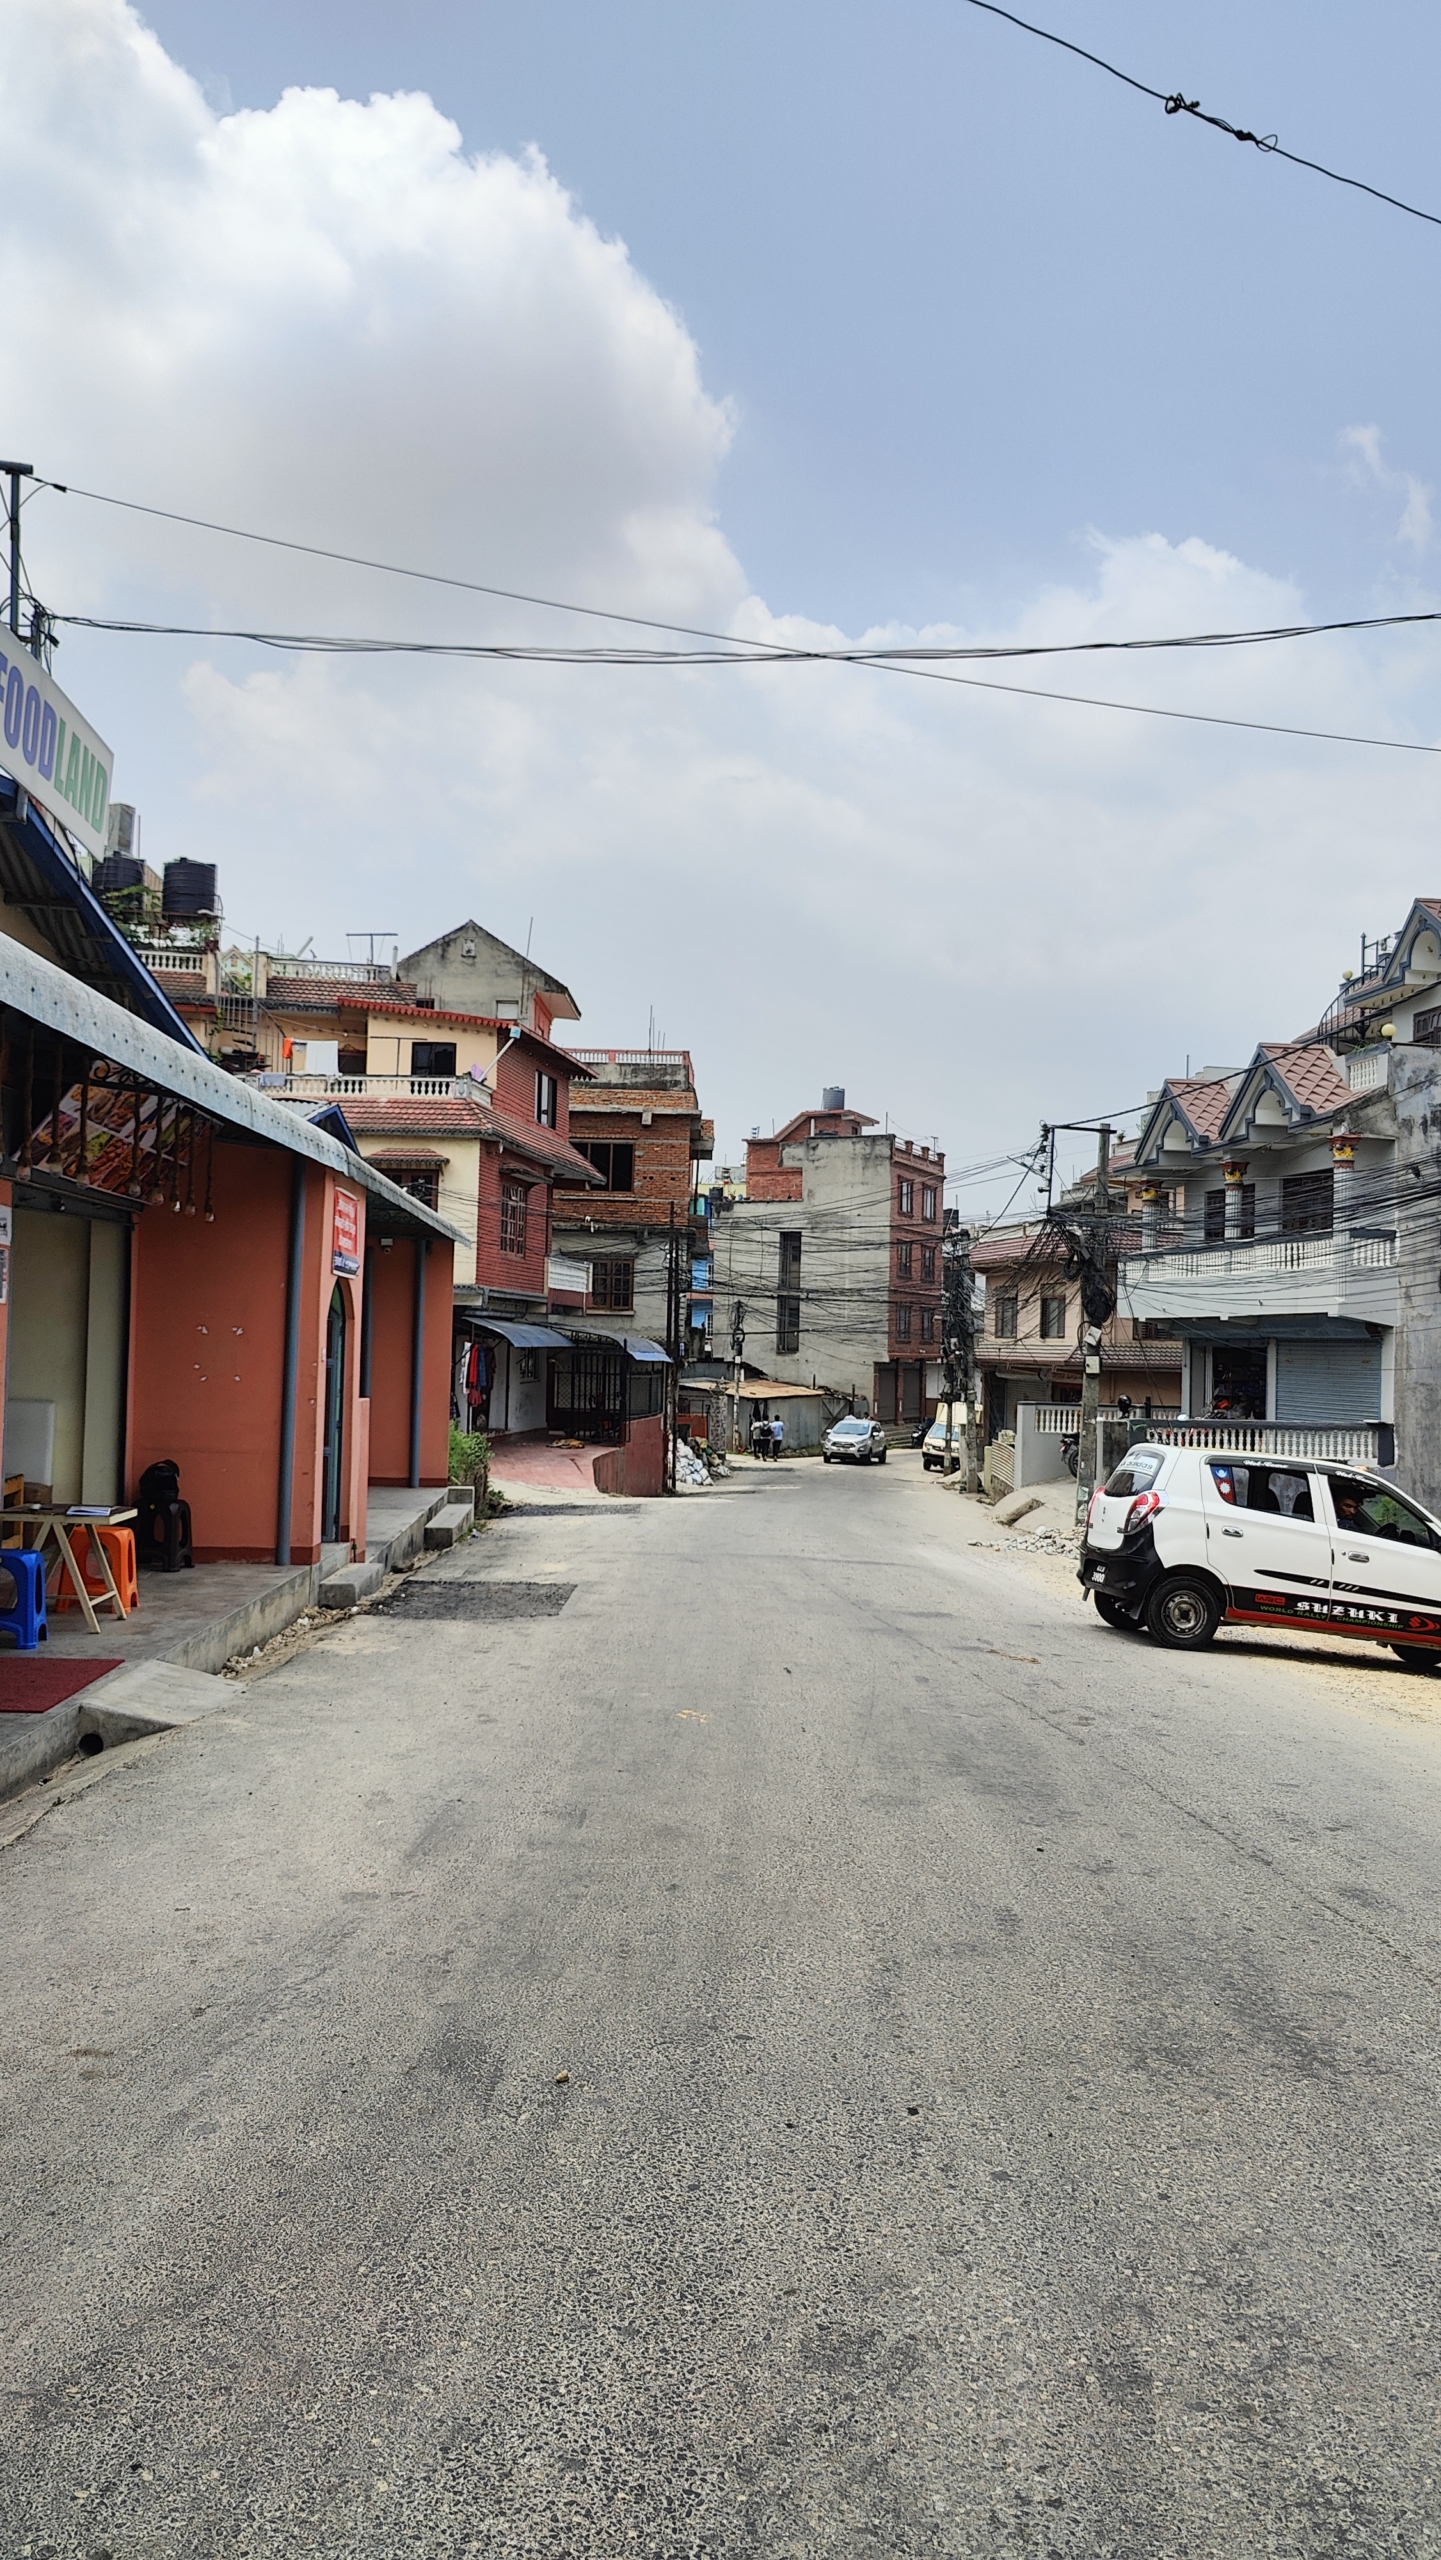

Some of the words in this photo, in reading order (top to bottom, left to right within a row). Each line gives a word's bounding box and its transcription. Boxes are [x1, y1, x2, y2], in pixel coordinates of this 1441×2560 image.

[1260, 1605, 1294, 1614] WORLD
[1297, 1610, 1327, 1619] RALLY
[1336, 1616, 1404, 1629] CHAMPIONSHIP
[1293, 1601, 1399, 1623] SUZUKI
